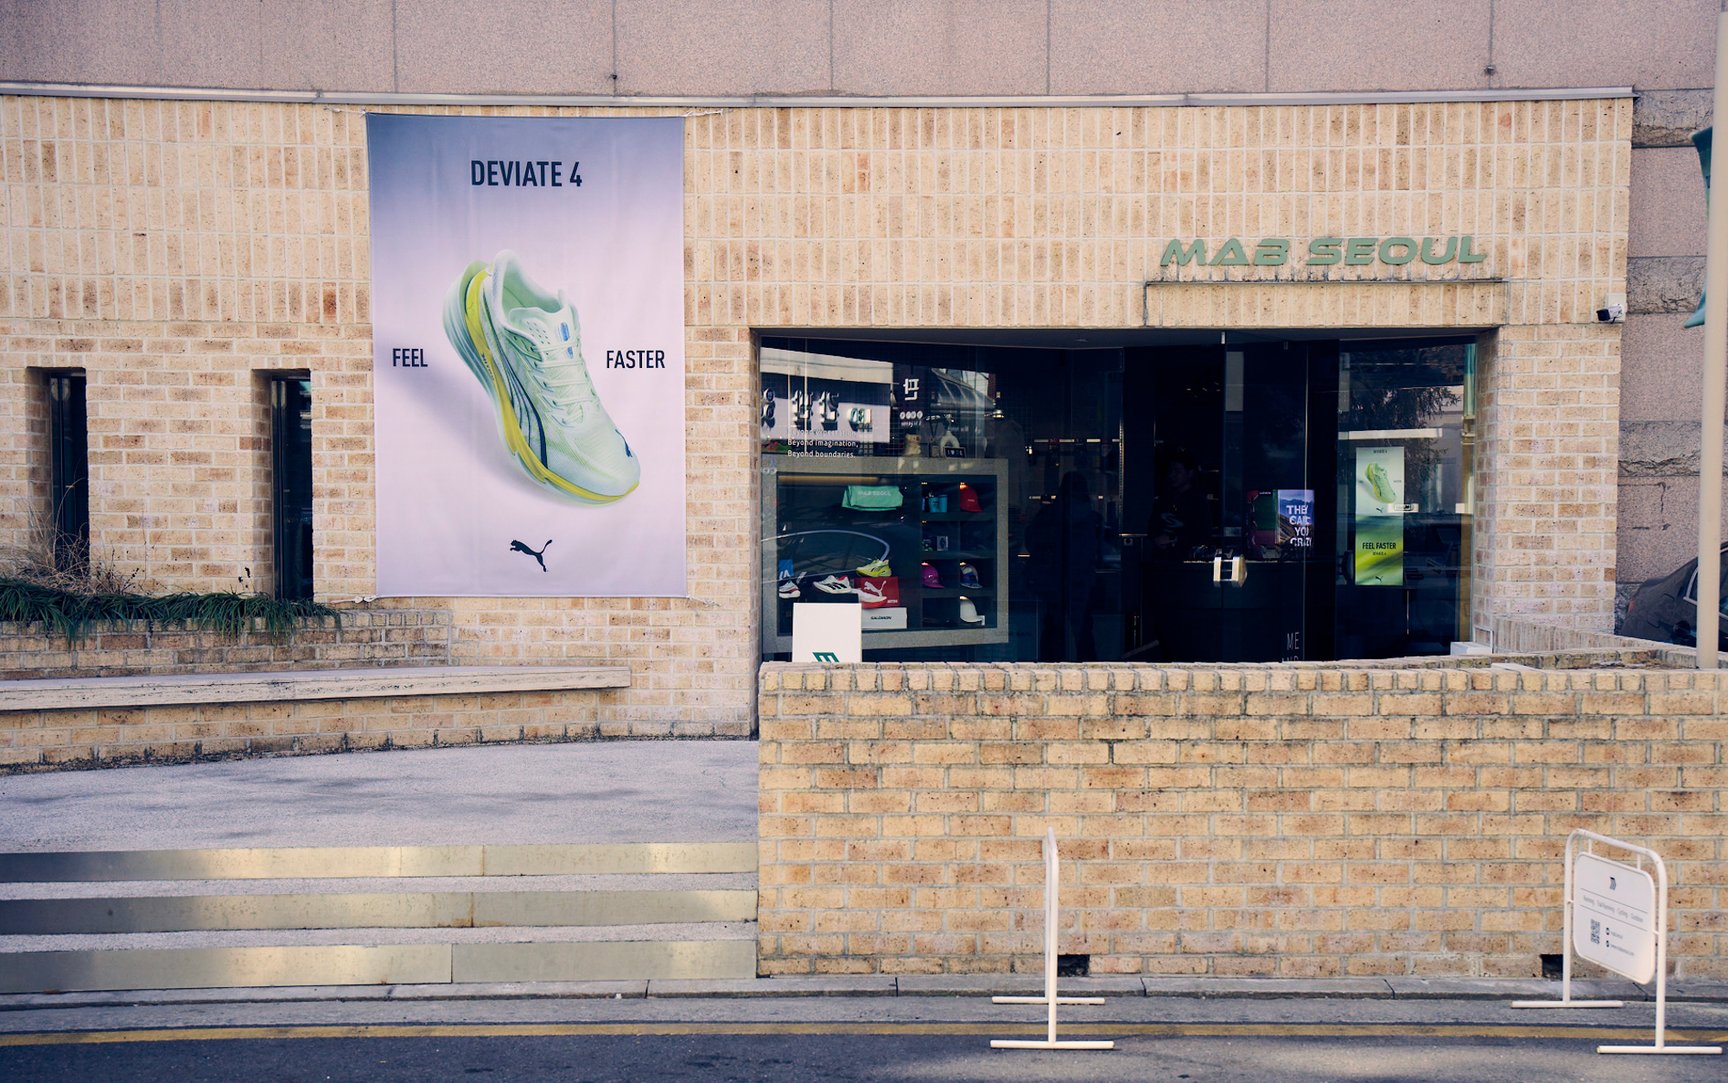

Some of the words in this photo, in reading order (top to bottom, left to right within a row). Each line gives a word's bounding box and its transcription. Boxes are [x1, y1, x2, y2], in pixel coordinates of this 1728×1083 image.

[471, 160, 562, 187] DEVIATE
[569, 161, 582, 187] 4
[1160, 238, 1290, 266] MAB
[1306, 236, 1486, 266] SEOUL
[392, 348, 428, 367] FEEL
[606, 350, 665, 368] FASTER
[787, 439, 813, 447] Beyond
[787, 449, 813, 458] Beyond
